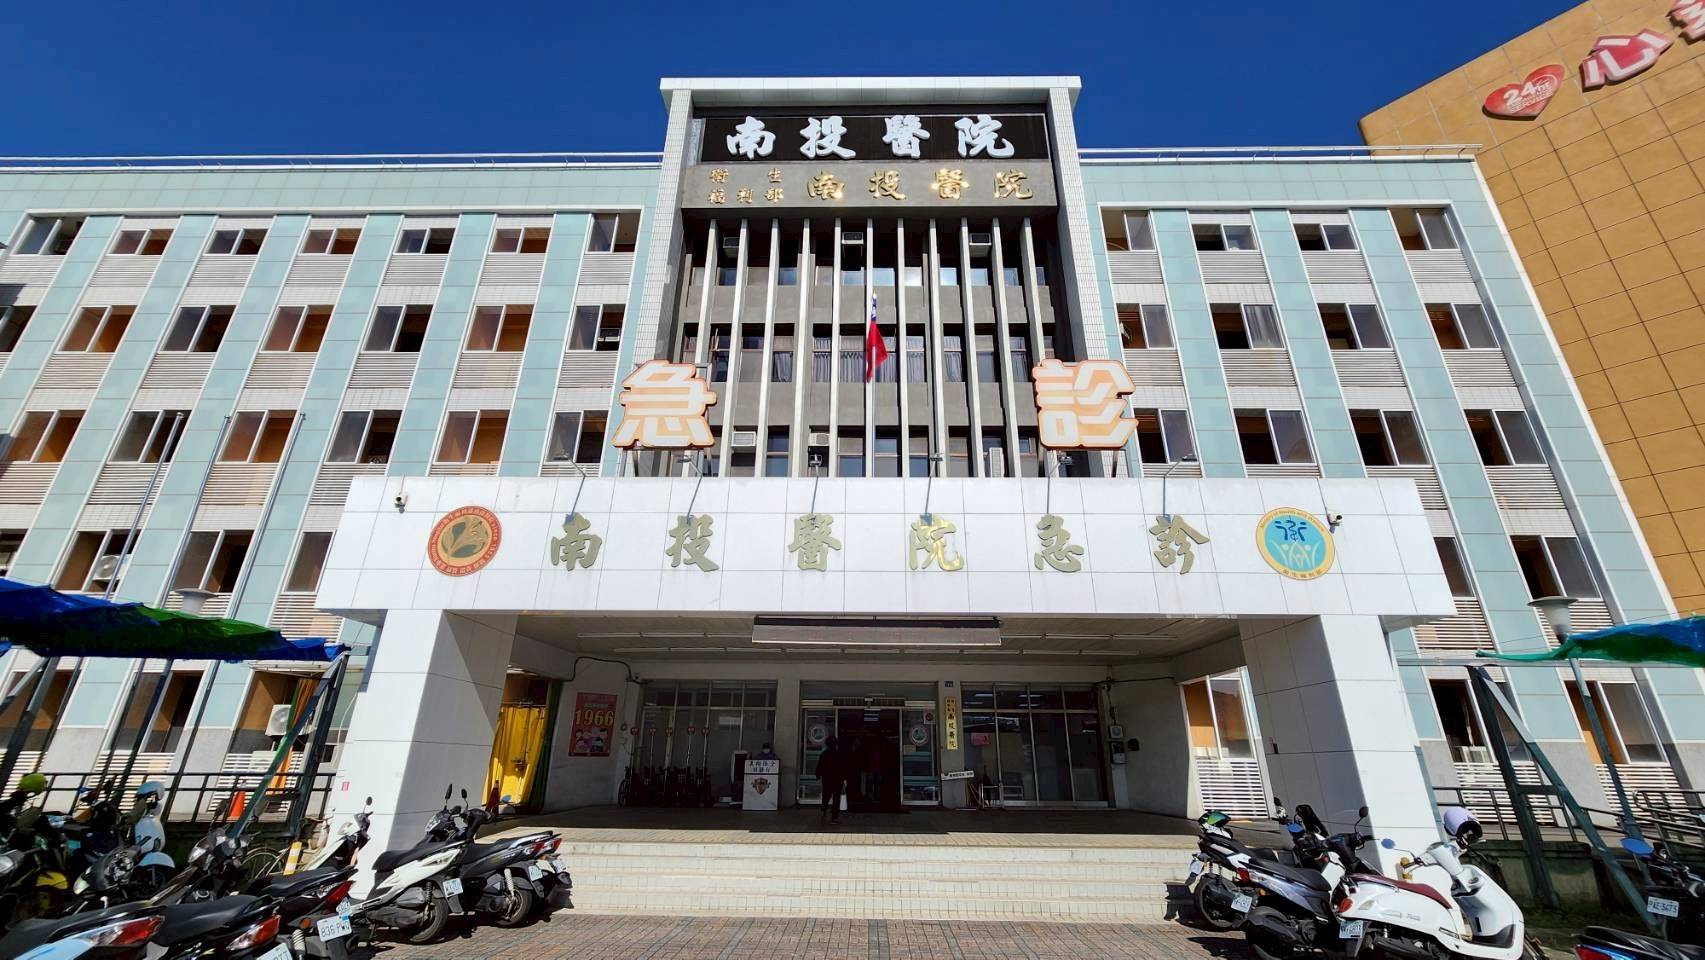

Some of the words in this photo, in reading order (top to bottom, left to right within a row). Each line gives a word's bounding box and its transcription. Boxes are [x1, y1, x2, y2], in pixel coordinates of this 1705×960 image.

[726, 115, 1015, 160] 南投醫院
[807, 168, 1033, 201] 南投醫院
[611, 359, 716, 447] 急
[1033, 359, 1139, 448] 診
[550, 513, 1210, 574] 南投醫院急診
[575, 709, 615, 728] 1966
